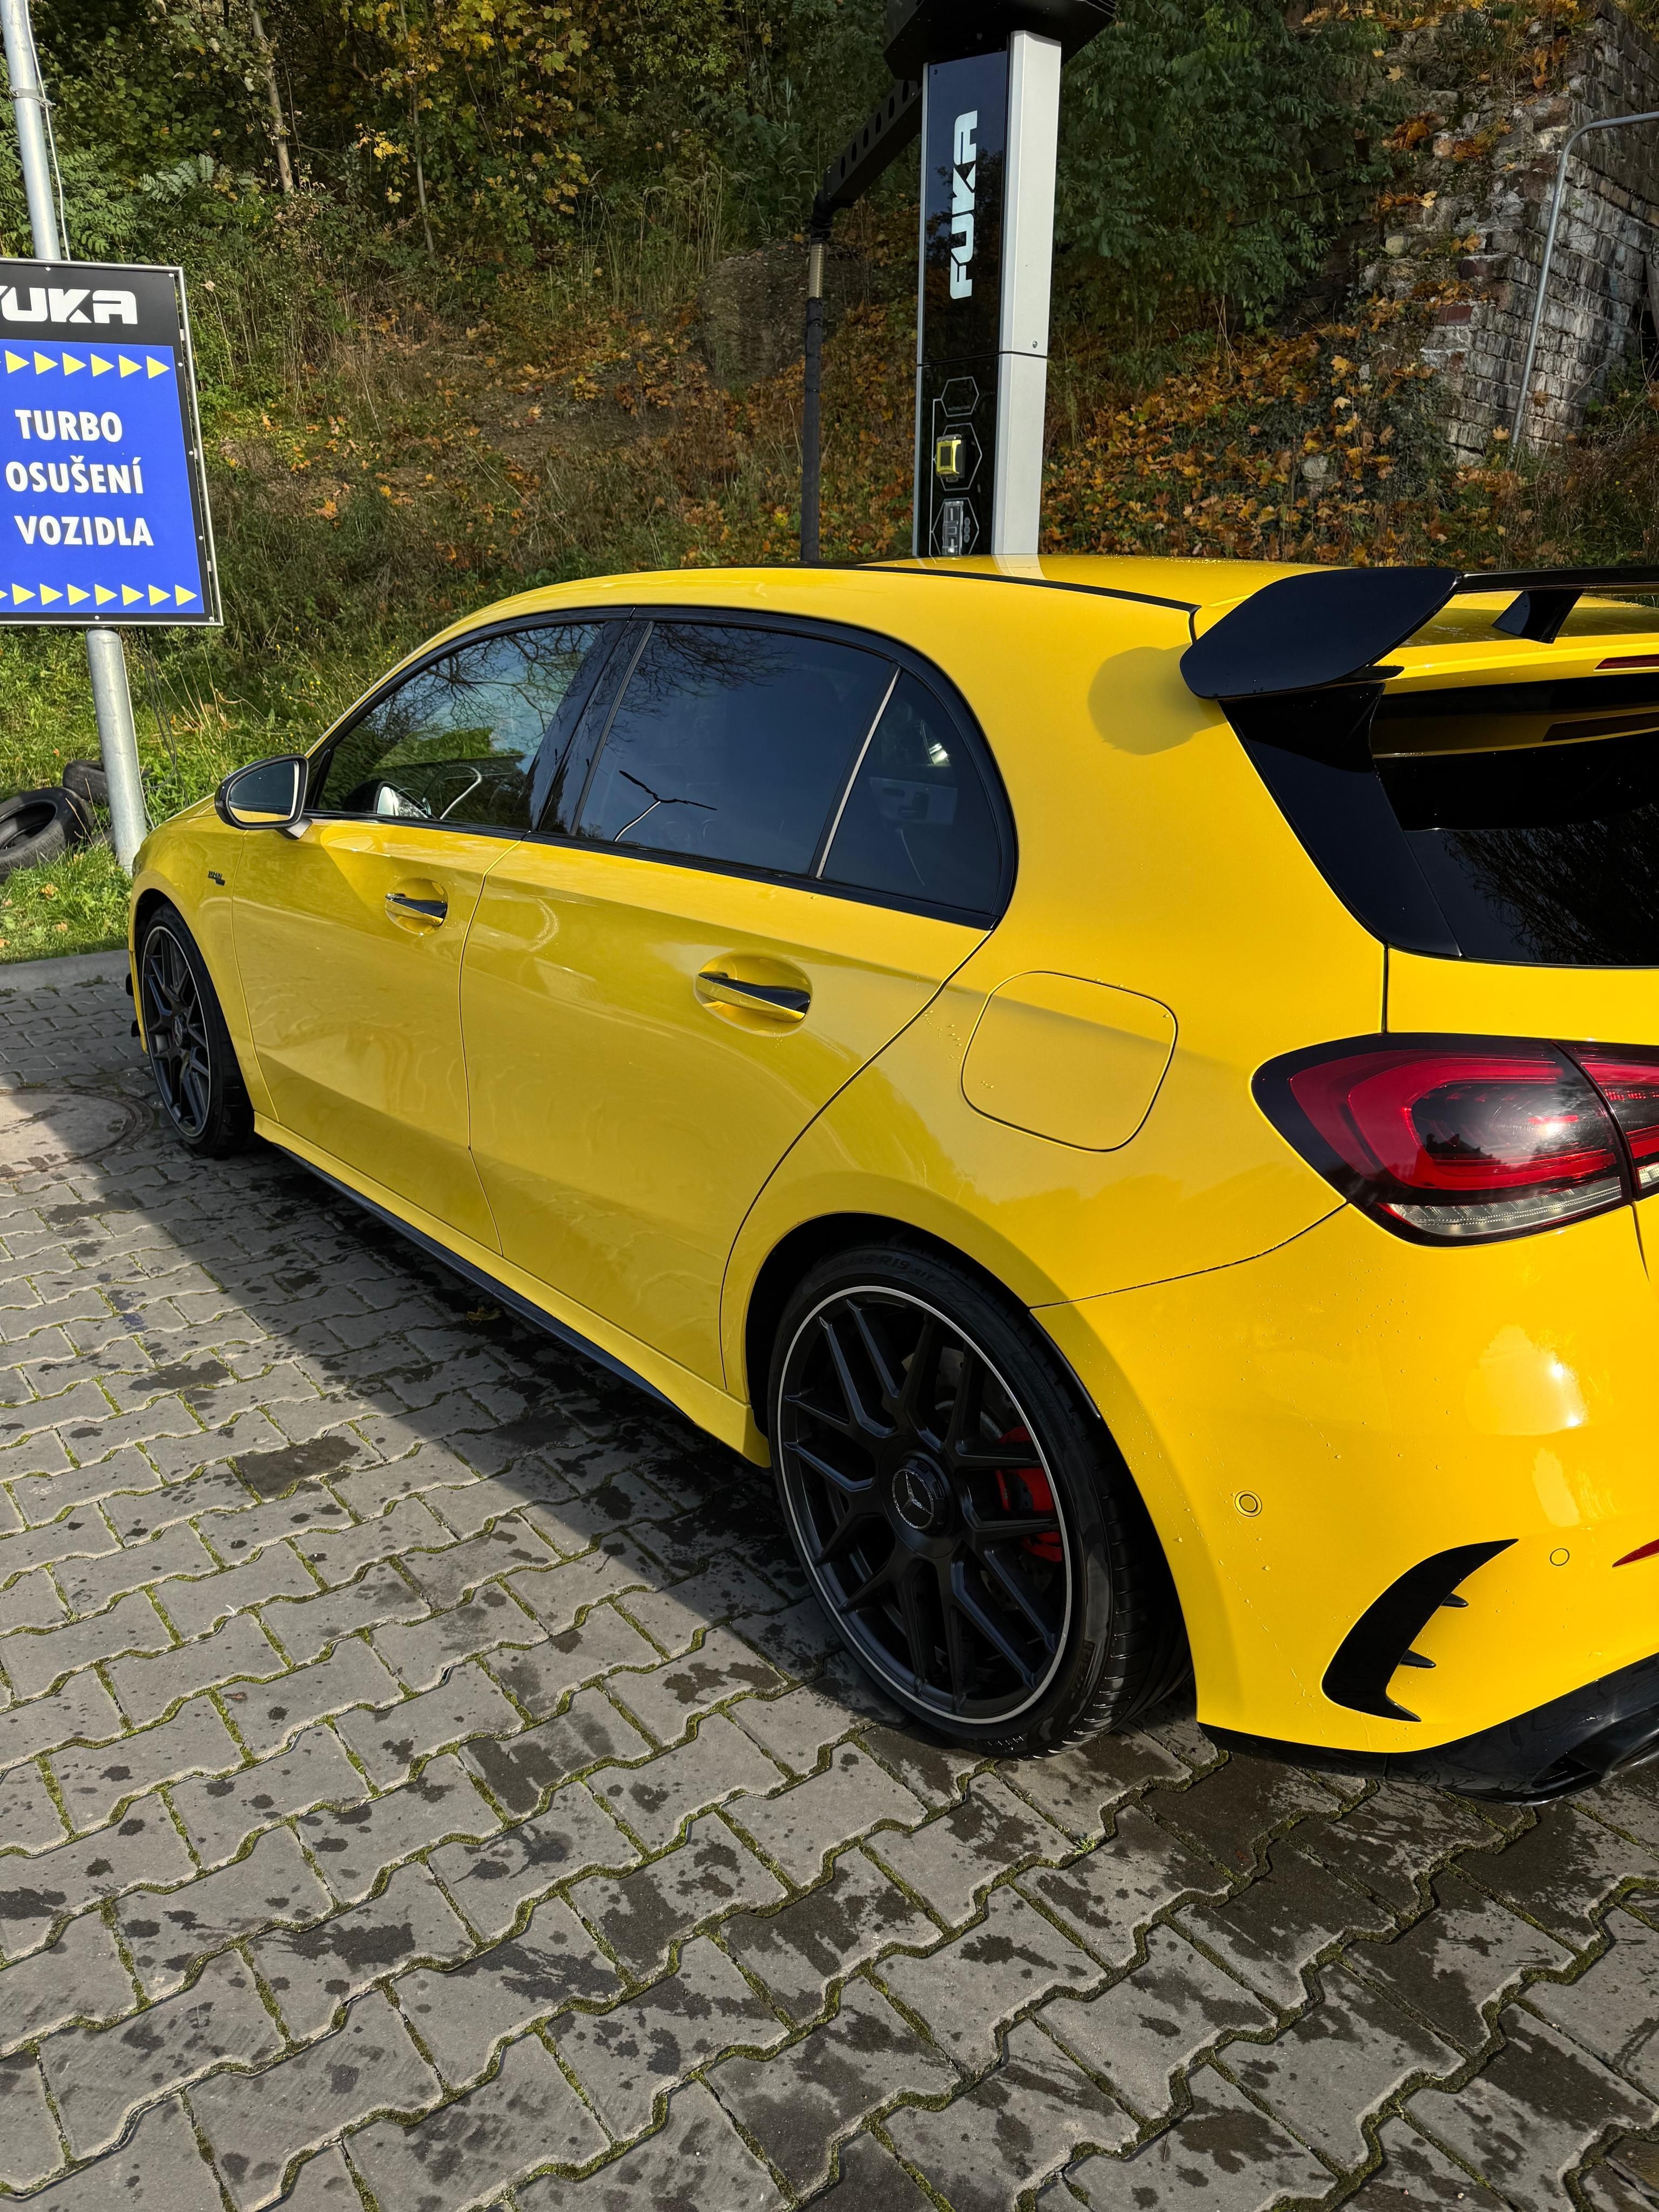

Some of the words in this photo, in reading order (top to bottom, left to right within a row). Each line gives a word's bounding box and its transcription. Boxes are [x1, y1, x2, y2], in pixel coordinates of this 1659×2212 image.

[949, 110, 977, 299] FUKA
[0, 285, 138, 325] UKA
[15, 409, 123, 442] TURBO
[5, 455, 144, 494] OSUŠENÍ
[14, 515, 154, 547] VOZIDLA
